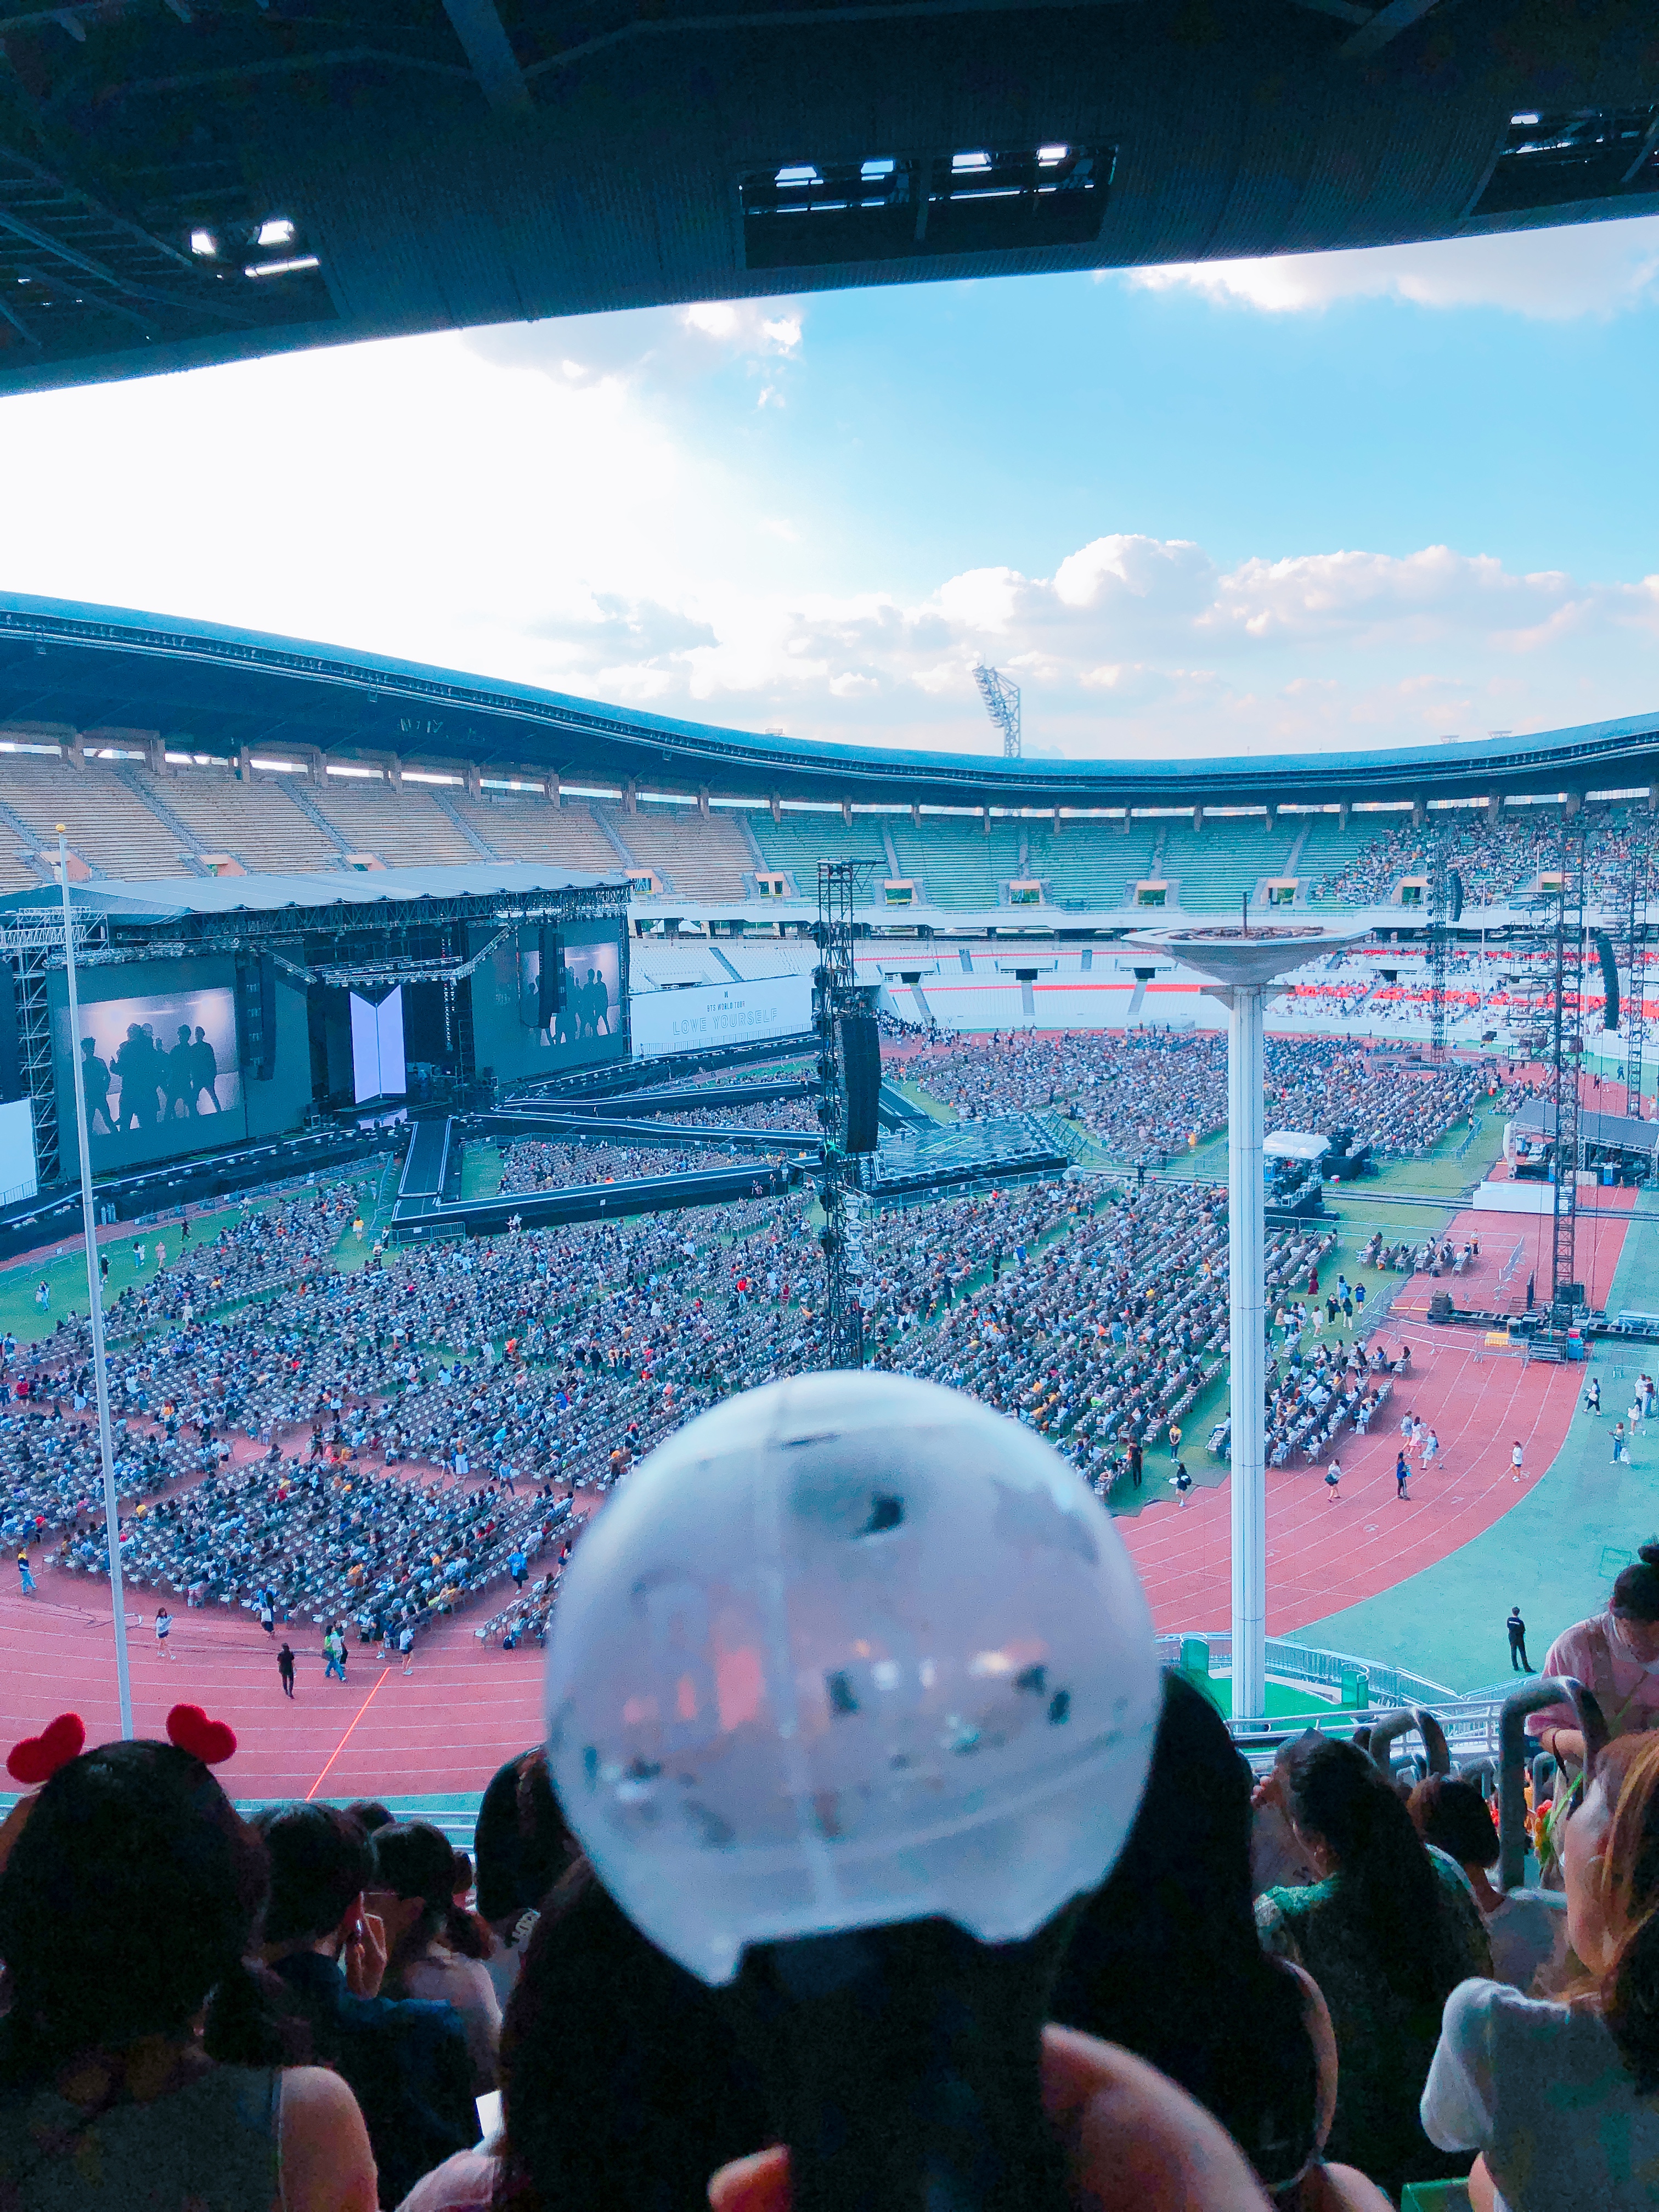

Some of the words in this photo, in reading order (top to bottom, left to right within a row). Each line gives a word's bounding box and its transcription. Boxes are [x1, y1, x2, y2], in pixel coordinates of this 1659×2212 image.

[718, 1002, 733, 1011] WORLD
[673, 1017, 707, 1035] LOVE
[712, 1008, 777, 1030] YOURSELF
